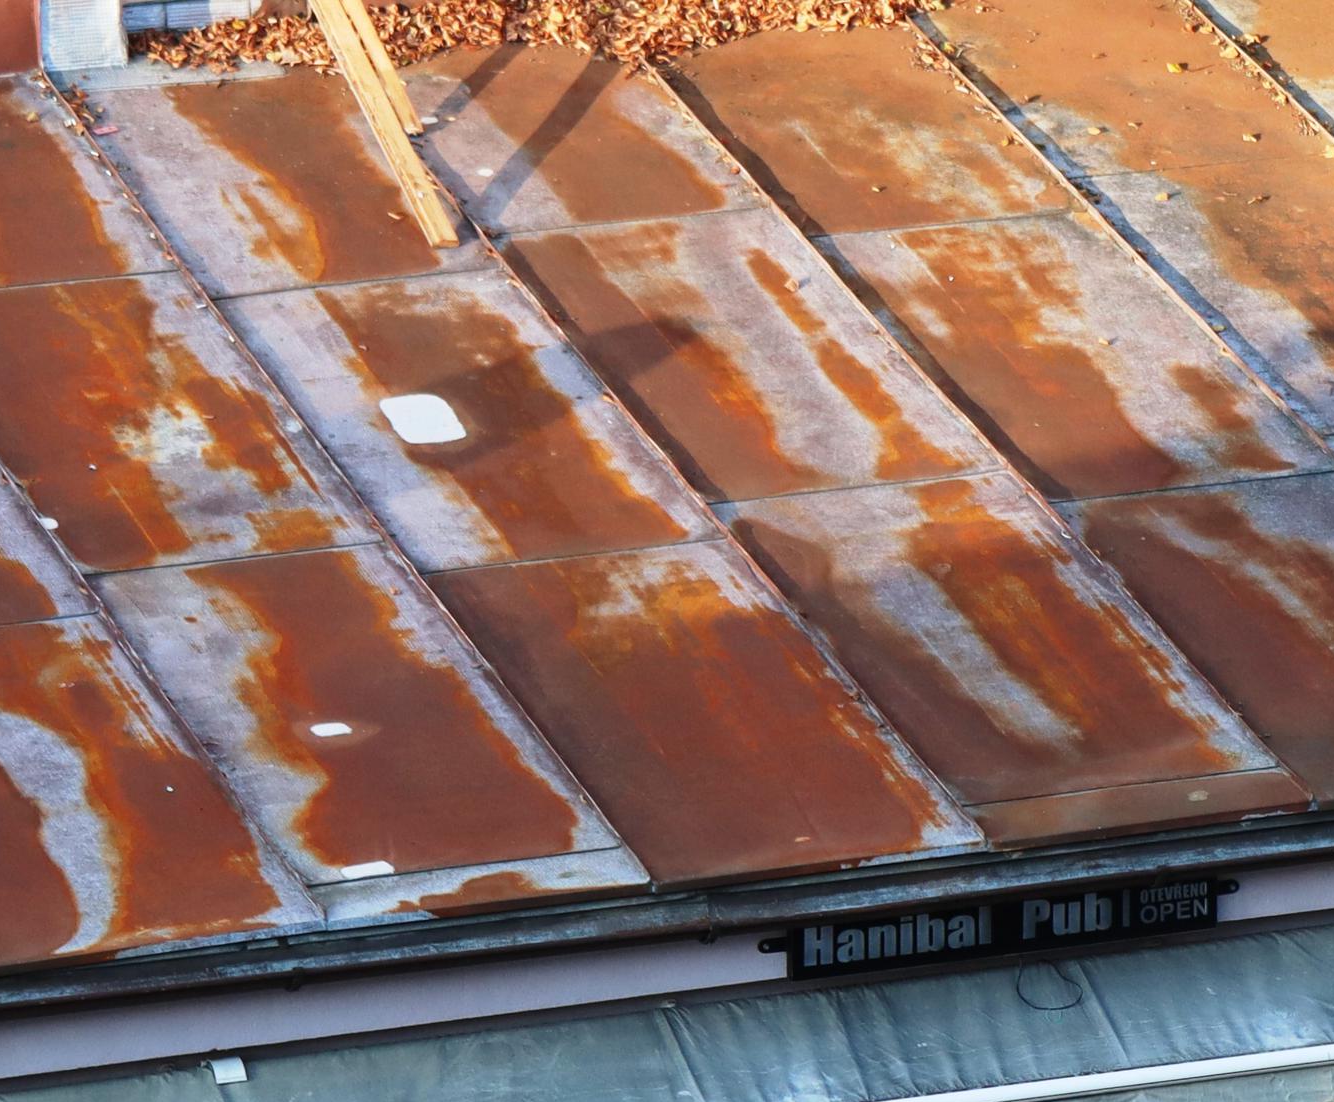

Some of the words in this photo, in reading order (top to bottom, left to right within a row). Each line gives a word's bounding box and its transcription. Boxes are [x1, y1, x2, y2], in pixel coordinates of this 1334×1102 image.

[1139, 880, 1208, 904] OTEVŘENO
[1139, 897, 1208, 925] OPEN
[803, 905, 993, 967] Hanibal
[1021, 892, 1113, 940] Pub
